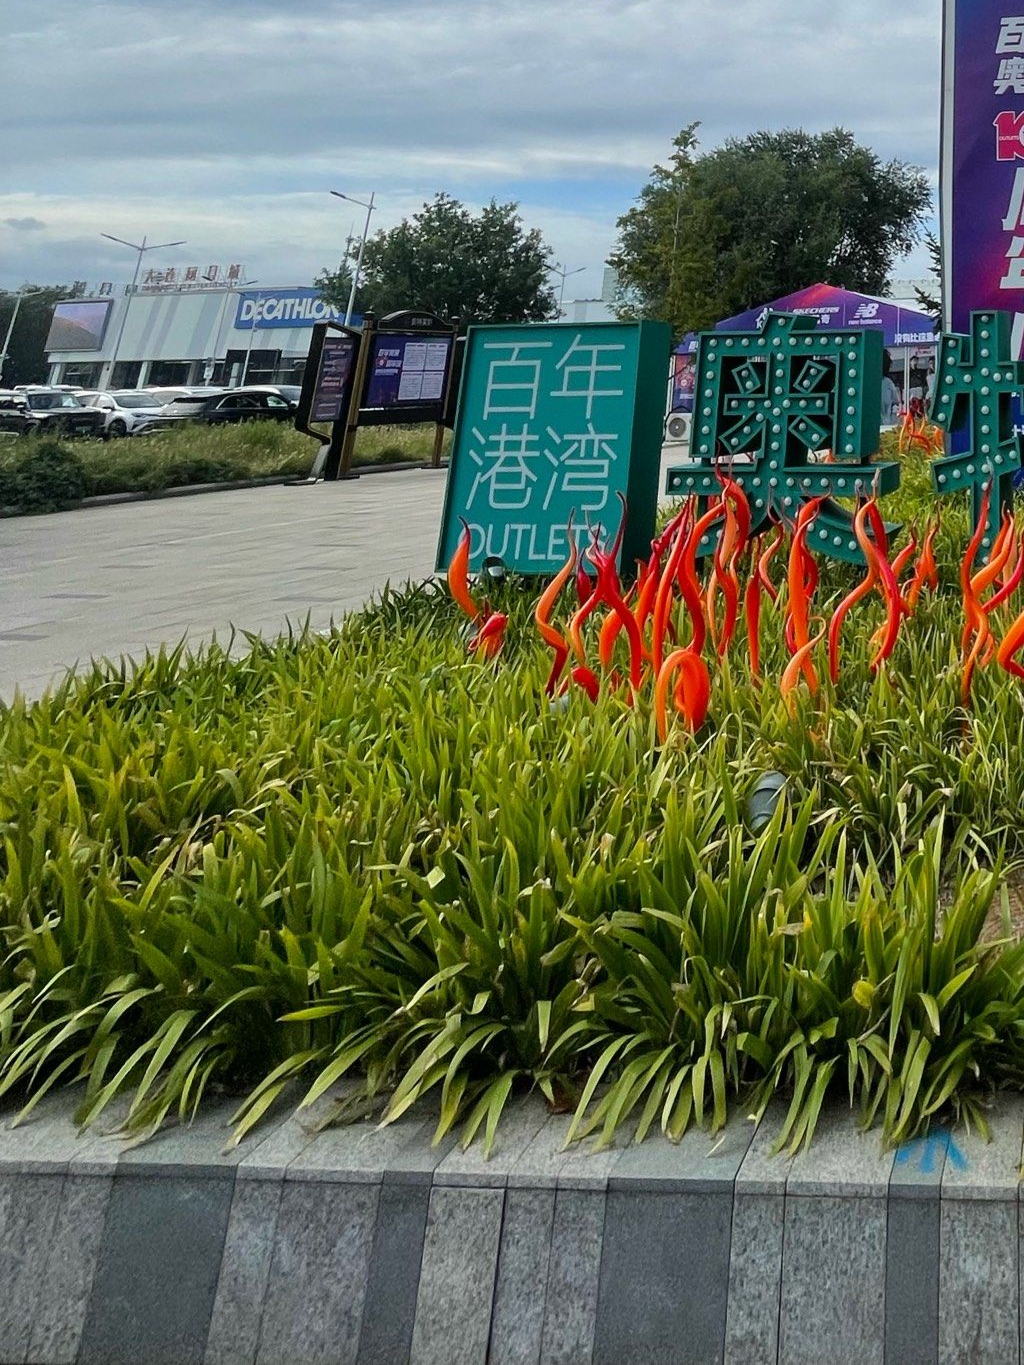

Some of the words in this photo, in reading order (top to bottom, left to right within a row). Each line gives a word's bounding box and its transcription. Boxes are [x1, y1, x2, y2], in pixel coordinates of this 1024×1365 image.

[1002, 130, 1024, 141] 10th
[240, 299, 341, 322] DECATHLON
[484, 334, 626, 420] 百年
[466, 423, 618, 510] 港湾
[458, 523, 611, 561] OUTLETS
